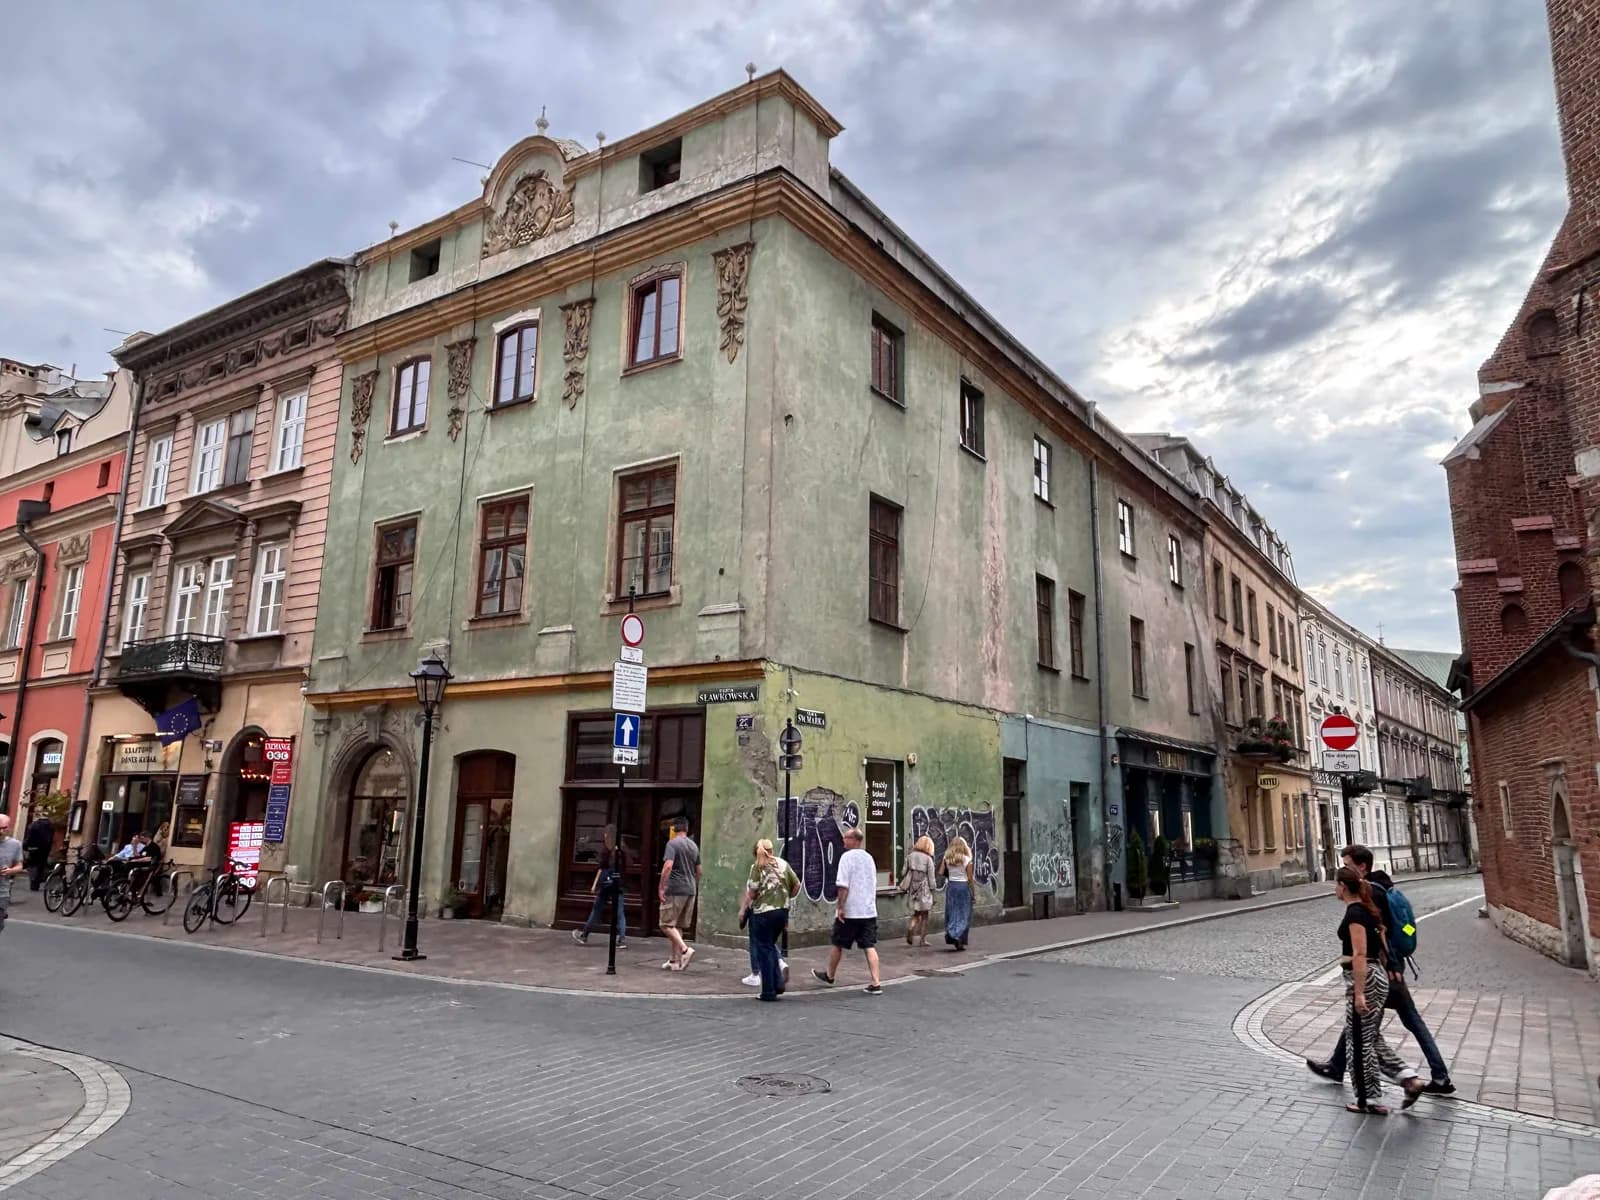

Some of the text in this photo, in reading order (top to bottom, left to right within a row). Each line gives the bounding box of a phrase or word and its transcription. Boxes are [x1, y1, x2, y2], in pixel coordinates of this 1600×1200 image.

[699, 691, 755, 702] SŁAWKOWSKA
[264, 742, 291, 751] EXCHANGE
[872, 780, 888, 791] Freshly
[872, 790, 886, 798] baked
[872, 799, 891, 809] chimney
